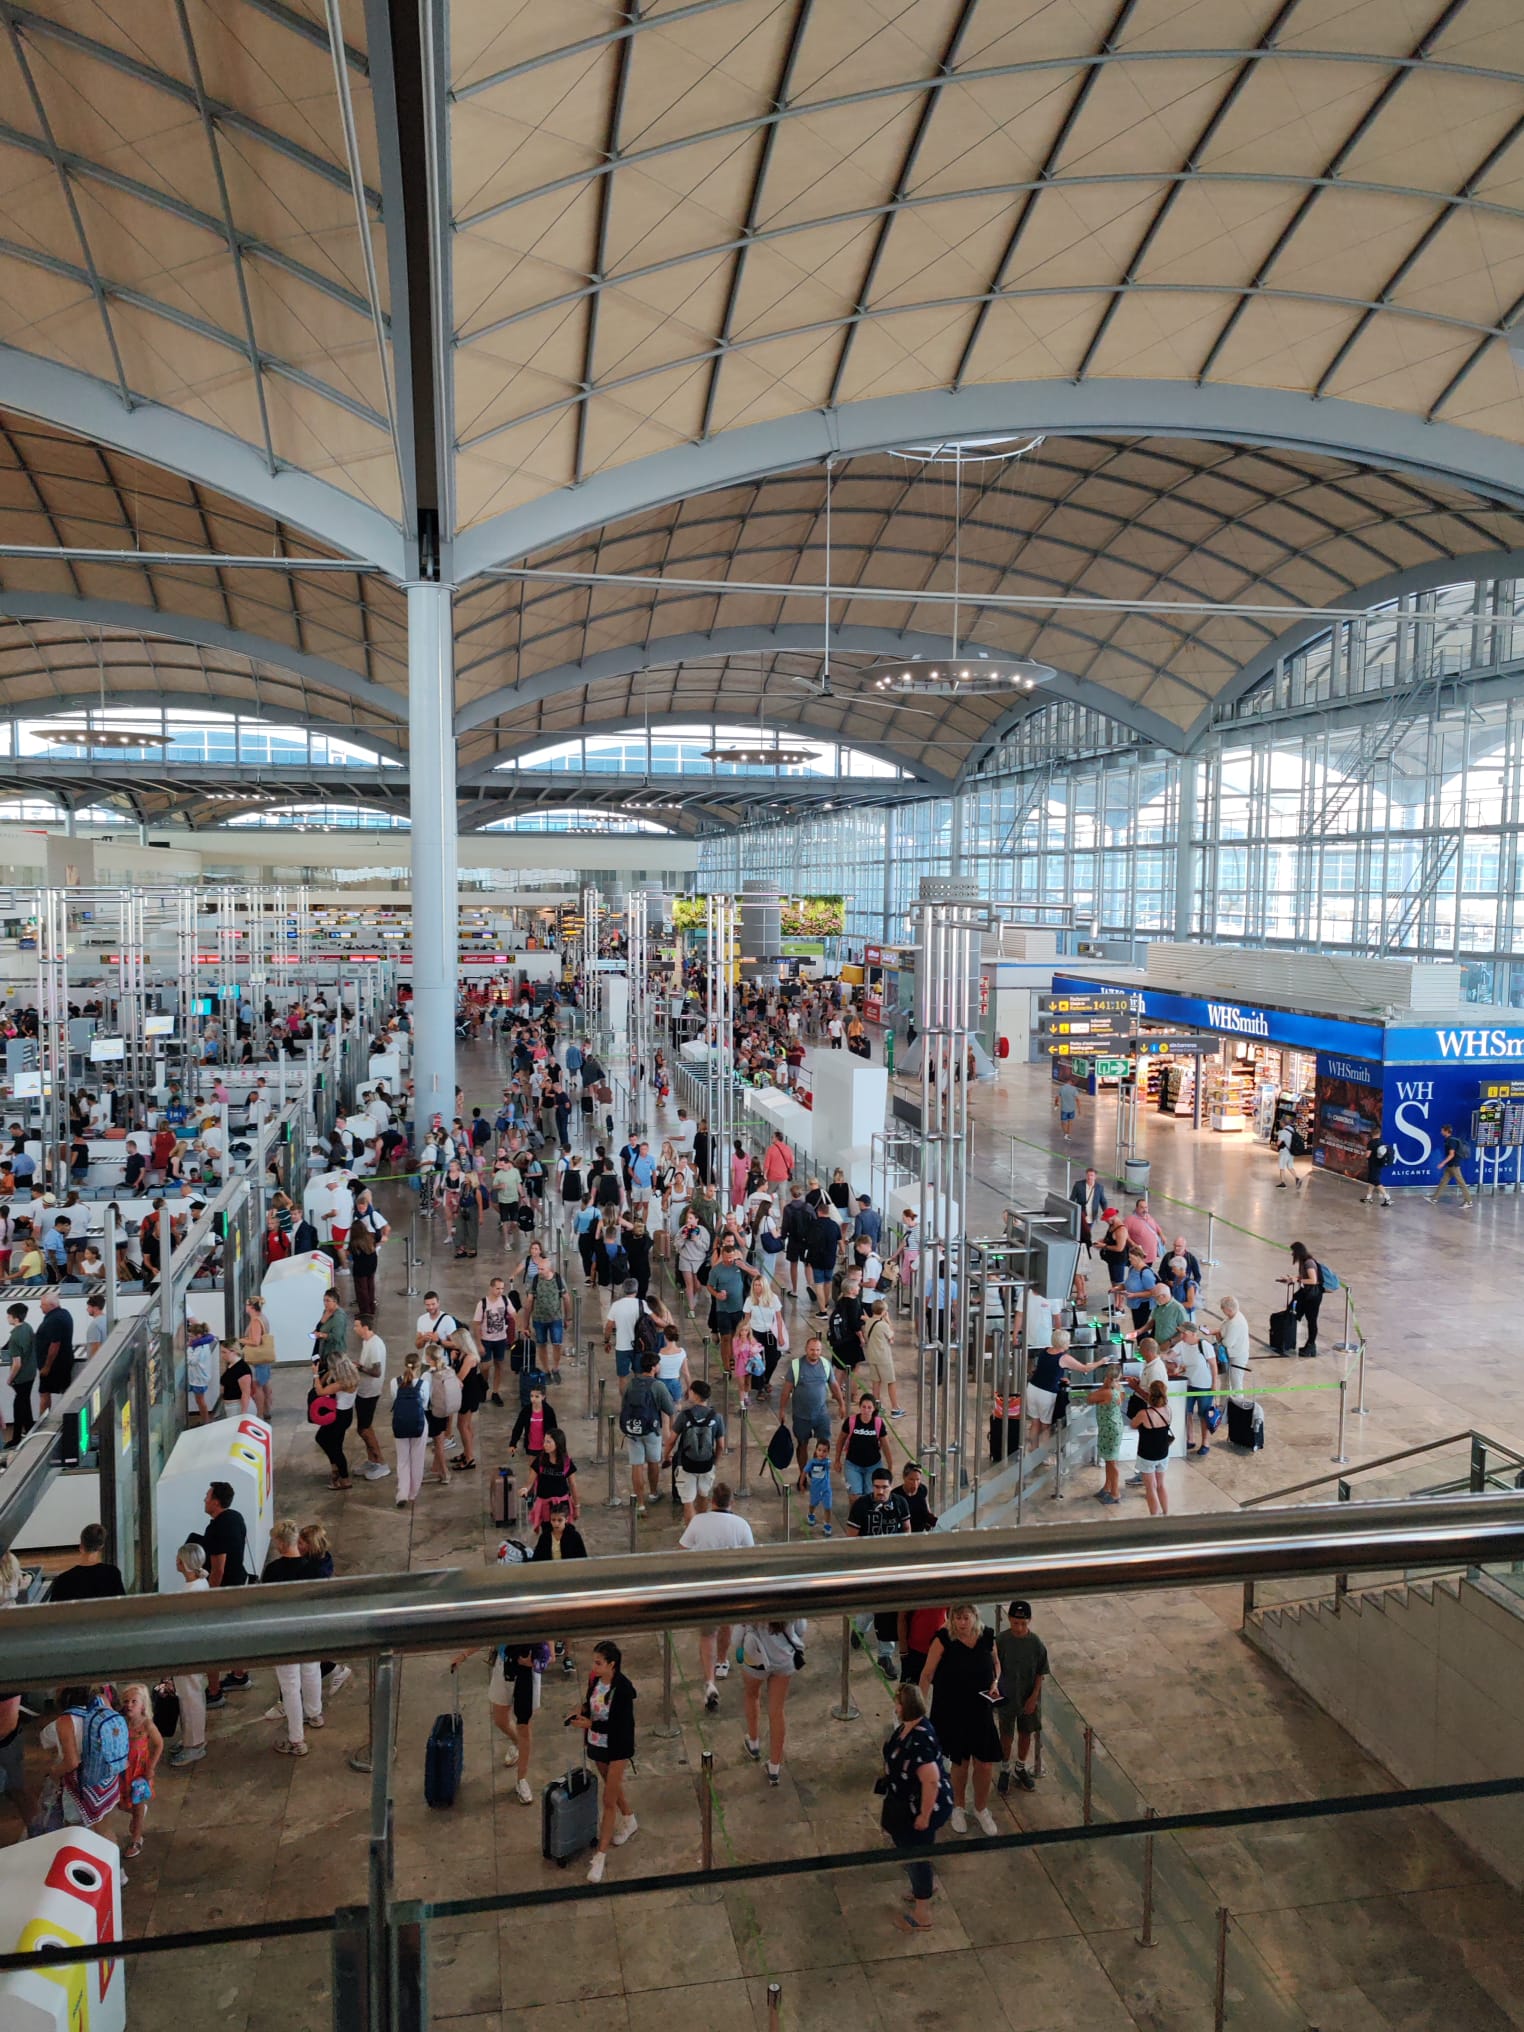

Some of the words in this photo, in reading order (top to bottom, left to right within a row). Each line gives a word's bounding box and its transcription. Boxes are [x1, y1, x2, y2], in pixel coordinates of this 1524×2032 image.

[1207, 1003, 1269, 1036] WHSmith
[1328, 1059, 1371, 1083] WHSmith
[1396, 1081, 1434, 1100] WH
[1392, 1100, 1432, 1166] S
[1474, 1166, 1513, 1174] AICNTE
[853, 1428, 877, 1436] adidas
